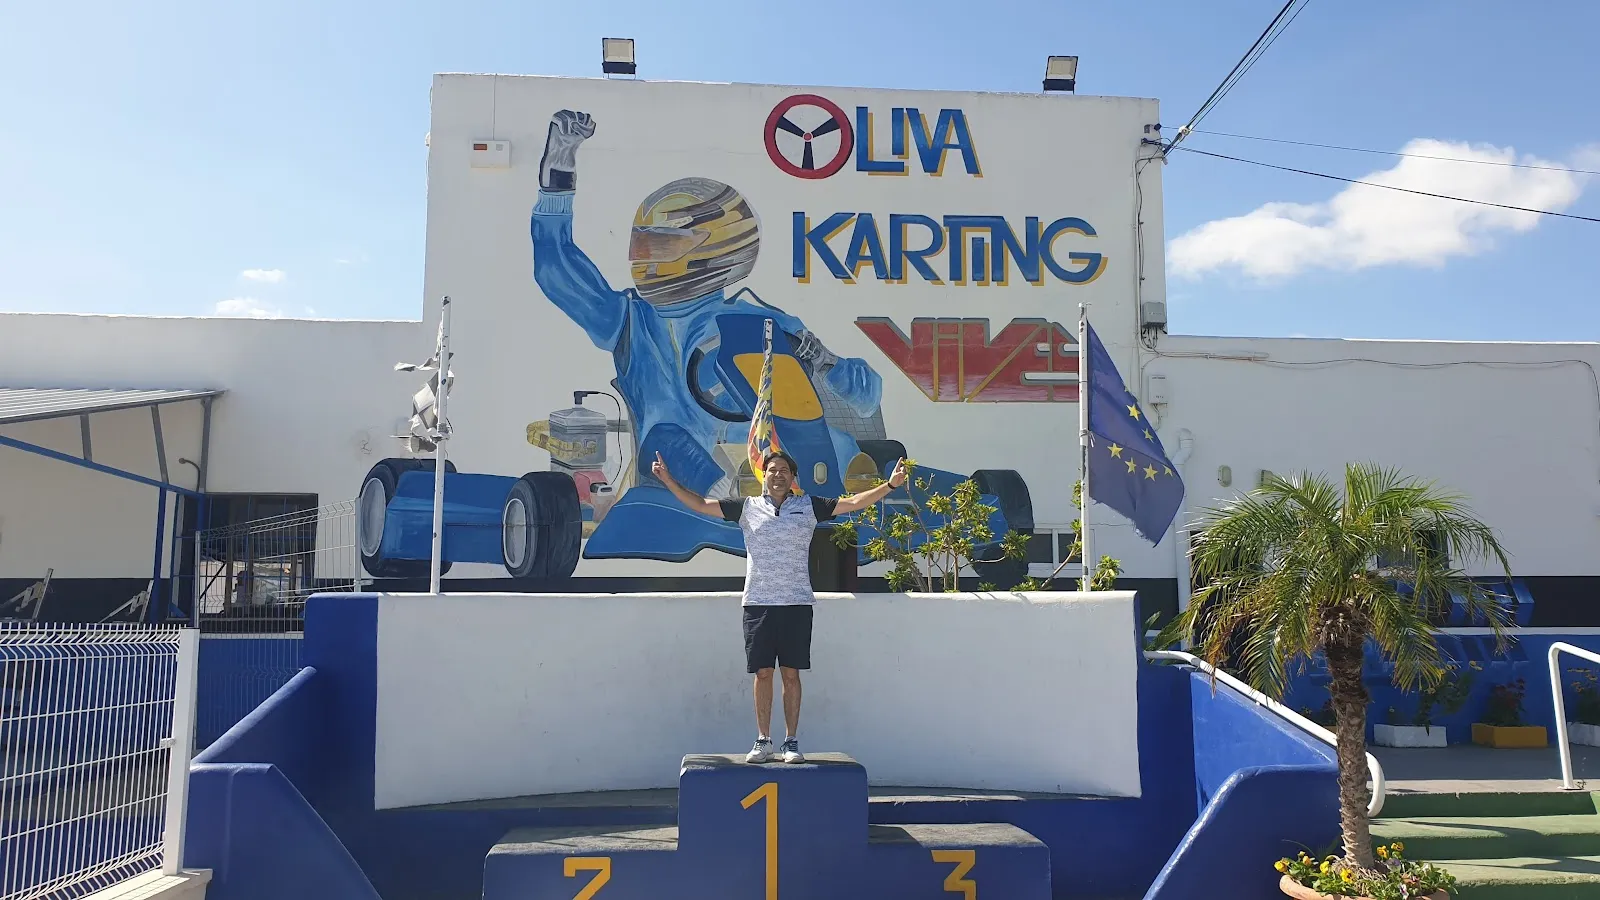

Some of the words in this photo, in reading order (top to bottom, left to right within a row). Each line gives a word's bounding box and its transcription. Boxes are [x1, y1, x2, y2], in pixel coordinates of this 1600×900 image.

[764, 94, 983, 178] OLIVA
[792, 211, 1108, 287] KARTING
[740, 782, 778, 900] 1
[931, 849, 976, 900] 3
